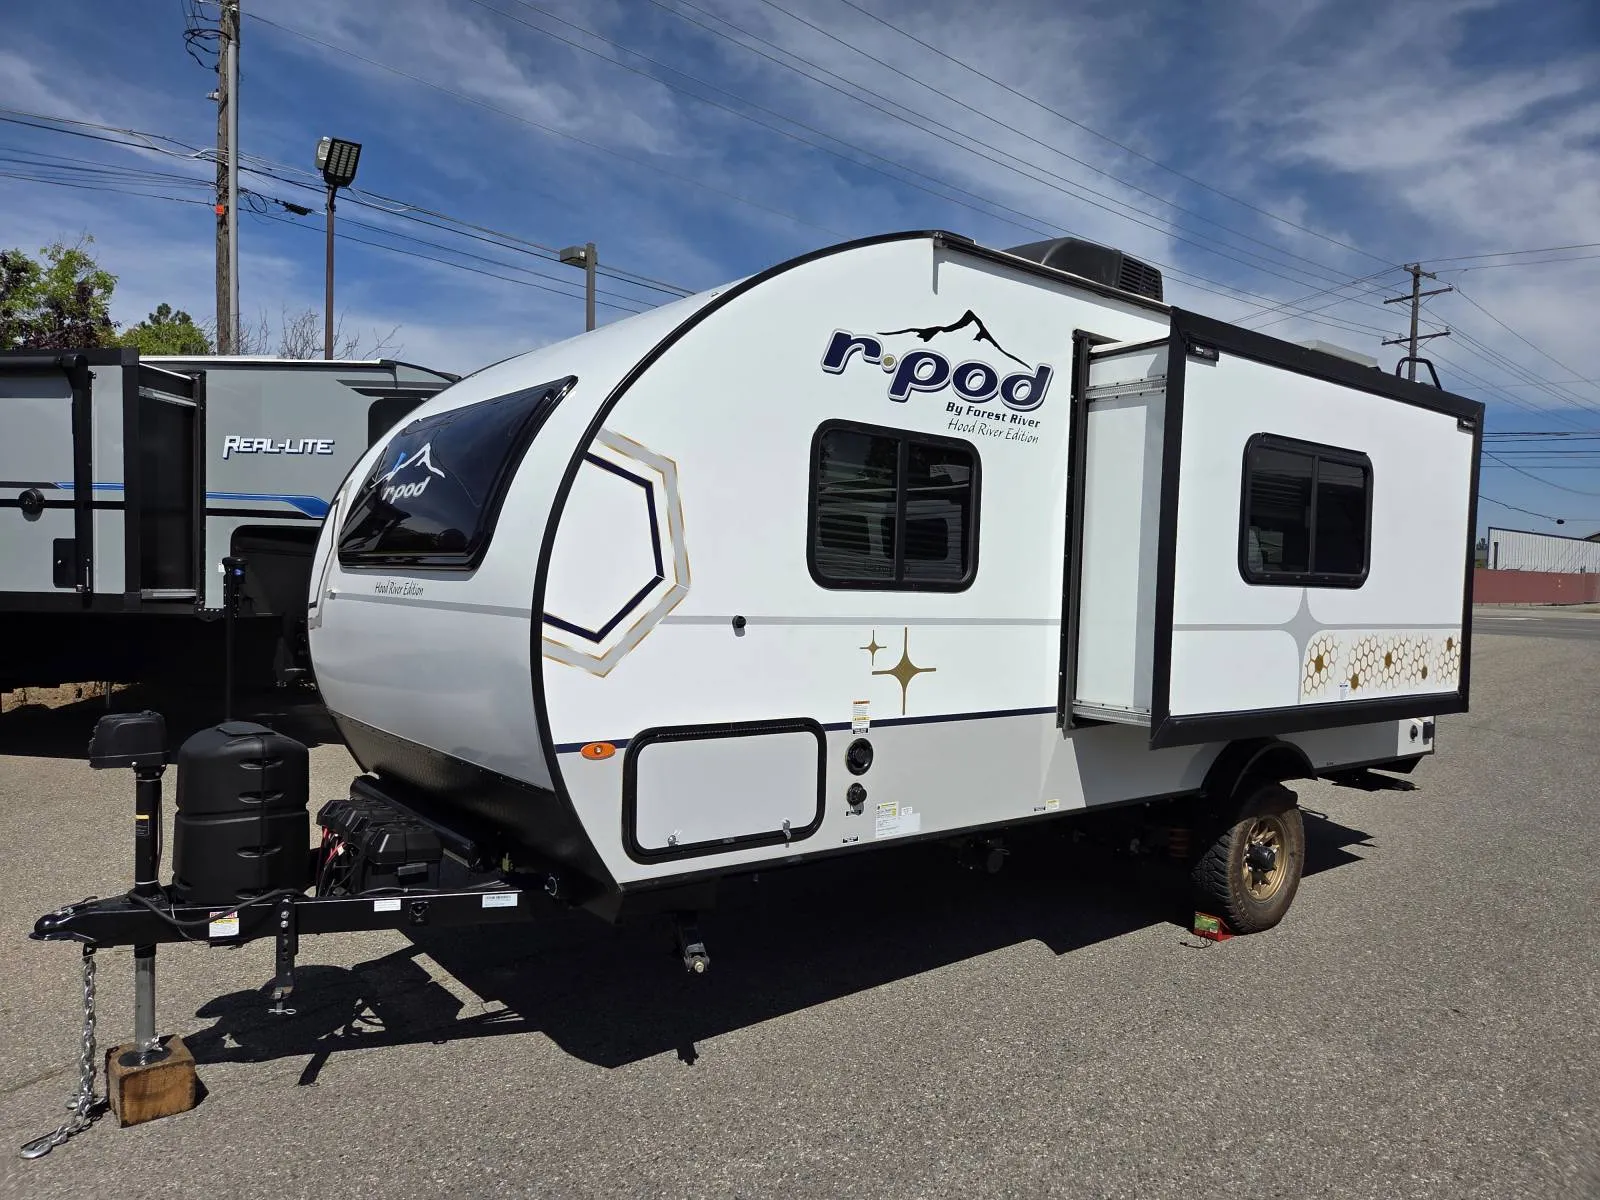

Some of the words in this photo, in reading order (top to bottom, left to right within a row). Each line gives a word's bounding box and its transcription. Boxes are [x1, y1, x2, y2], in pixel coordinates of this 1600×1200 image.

[946, 401, 963, 416] By
[966, 405, 1007, 422] Forest
[1009, 413, 1041, 428] River
[948, 417, 978, 434] Hood
[977, 422, 1004, 438] River
[1005, 427, 1039, 444] Edition
[374, 580, 390, 594] Hood
[403, 580, 424, 596] Edition
